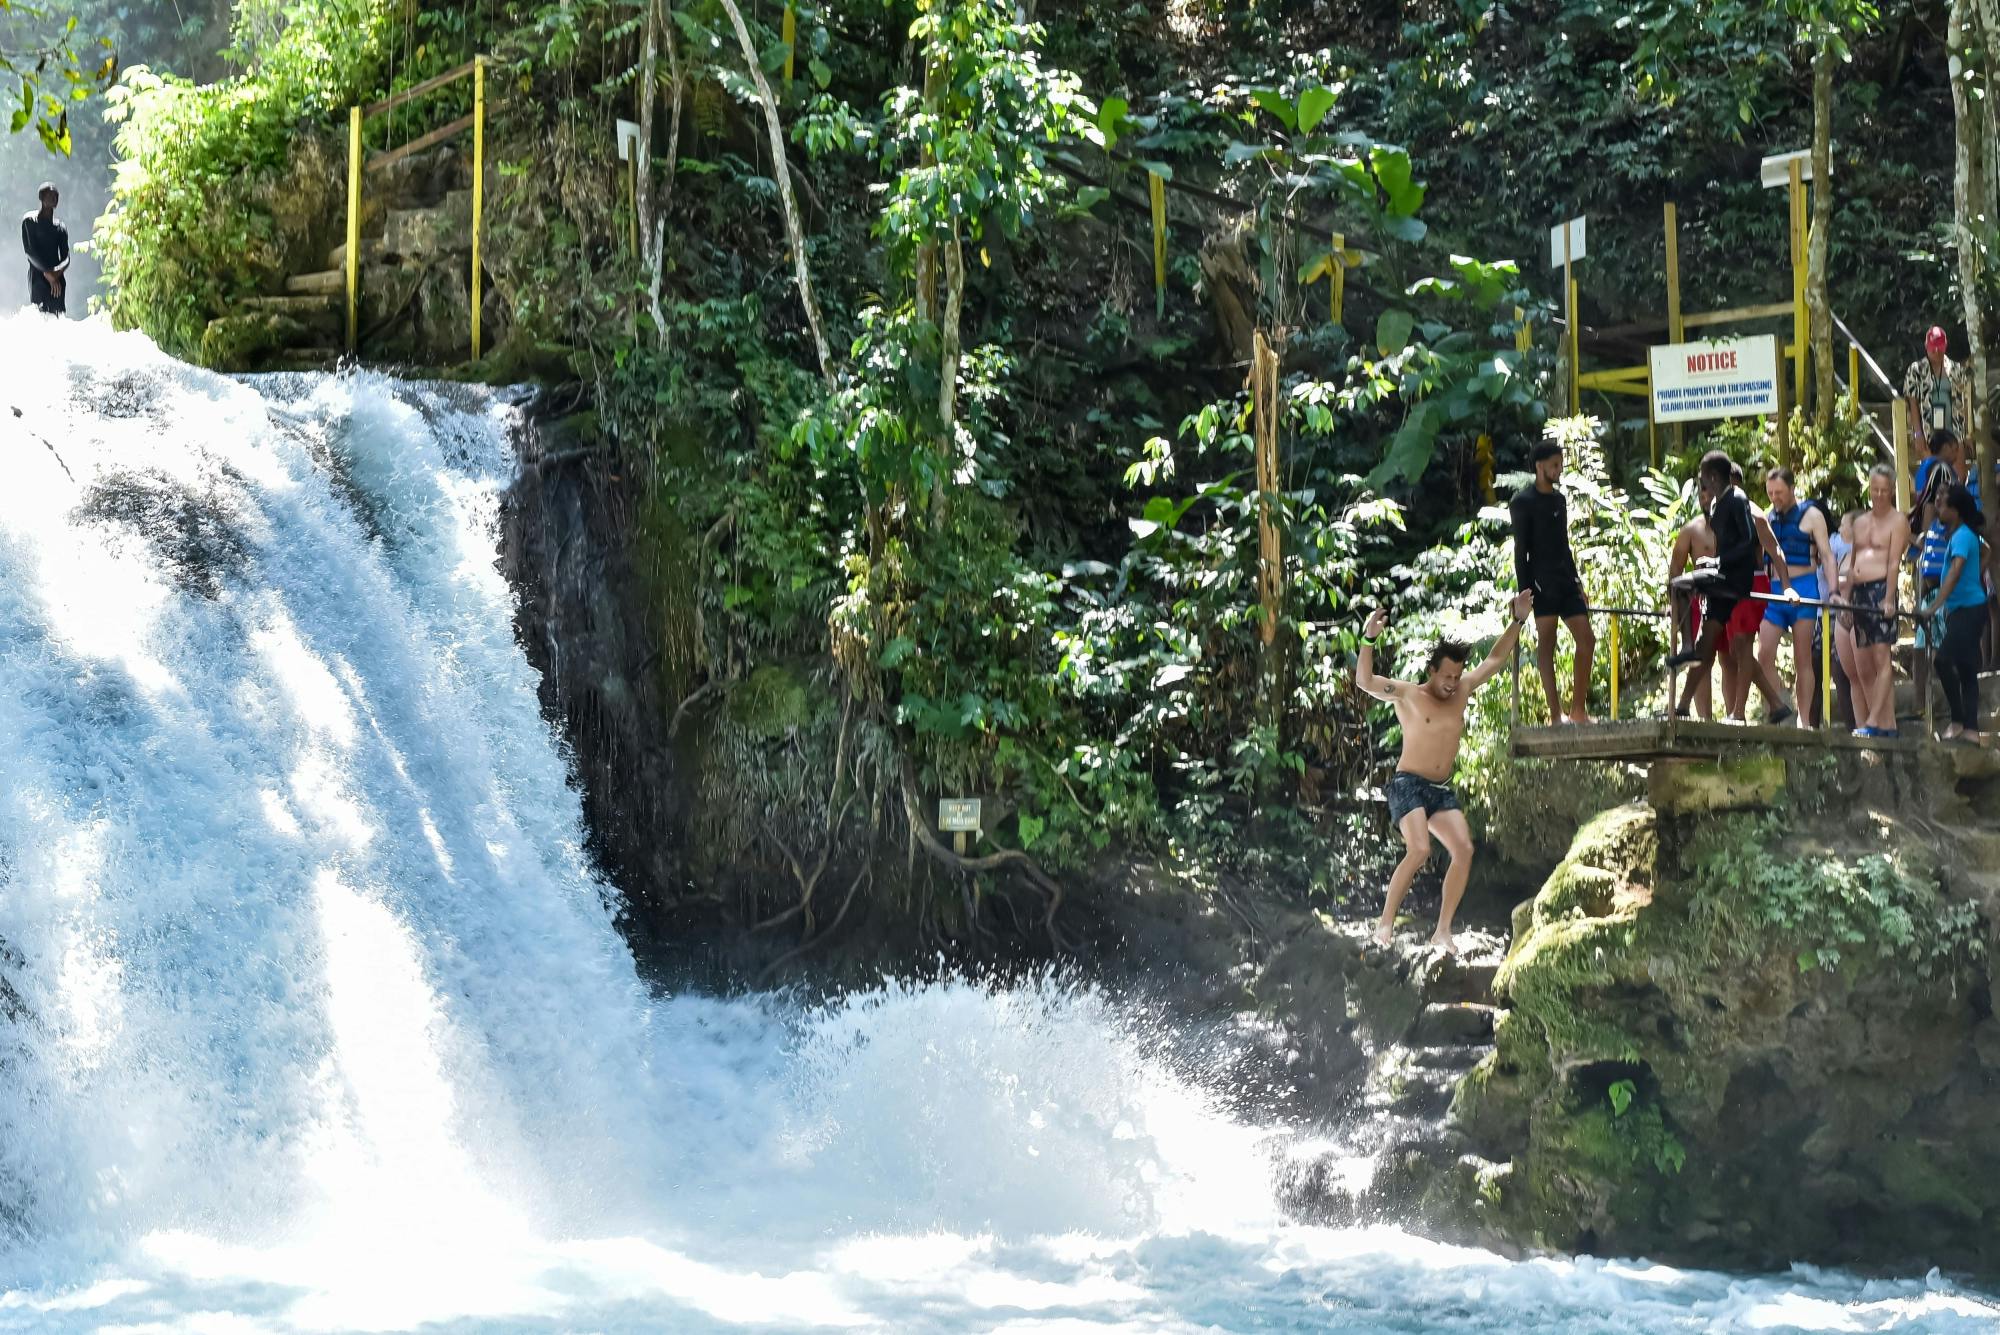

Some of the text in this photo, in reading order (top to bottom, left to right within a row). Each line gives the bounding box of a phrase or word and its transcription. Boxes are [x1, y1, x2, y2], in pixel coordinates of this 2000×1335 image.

[1687, 351, 1737, 372] NOTICE
[1657, 380, 1772, 400] PRIVATE PROPERTY NO TRESPASSING
[1661, 393, 1769, 413] ISLAND GULLY FALLS VISITORS ONLY
